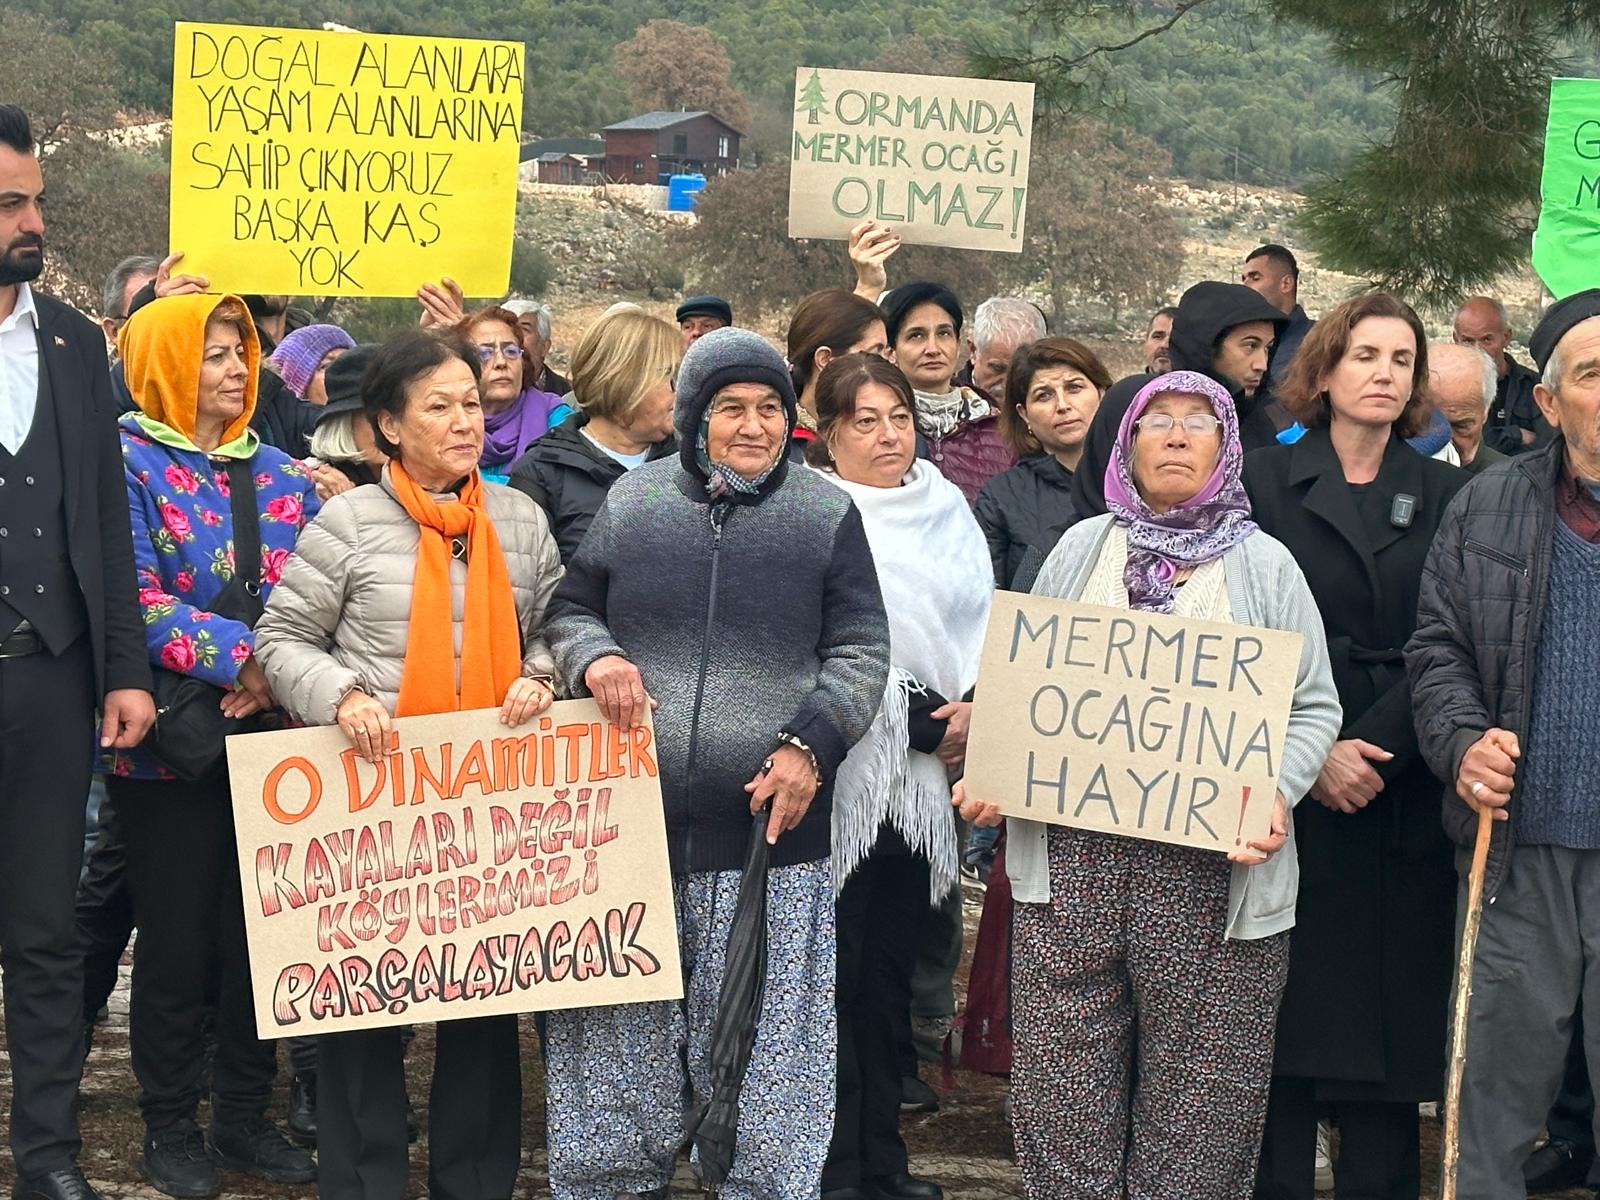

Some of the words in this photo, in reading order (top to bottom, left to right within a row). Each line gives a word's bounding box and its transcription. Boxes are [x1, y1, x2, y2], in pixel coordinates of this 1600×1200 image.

[191, 32, 335, 92] DOĞAL
[350, 42, 523, 94] ALANLARA
[197, 85, 312, 135] YAŞAM
[327, 92, 520, 143] ALANLARINA
[835, 89, 1023, 137] ORMANDA
[190, 139, 290, 190] SAHİP
[299, 147, 454, 197] ÇIKIYORUZ
[793, 130, 912, 168] MERMER
[921, 140, 1018, 177] OCAĞI
[234, 195, 339, 244] BAŞKA
[364, 200, 441, 247] KAŞ
[832, 176, 1026, 240] OLMAZ!
[290, 246, 364, 289] YOK
[1009, 609, 1263, 696] MERMER
[1029, 684, 1274, 778] OCAĞINA
[262, 756, 323, 825] O
[255, 806, 478, 917] KAYALARI
[489, 787, 619, 866] DEĞİL
[273, 902, 661, 1026] PARÇALAYACAK
